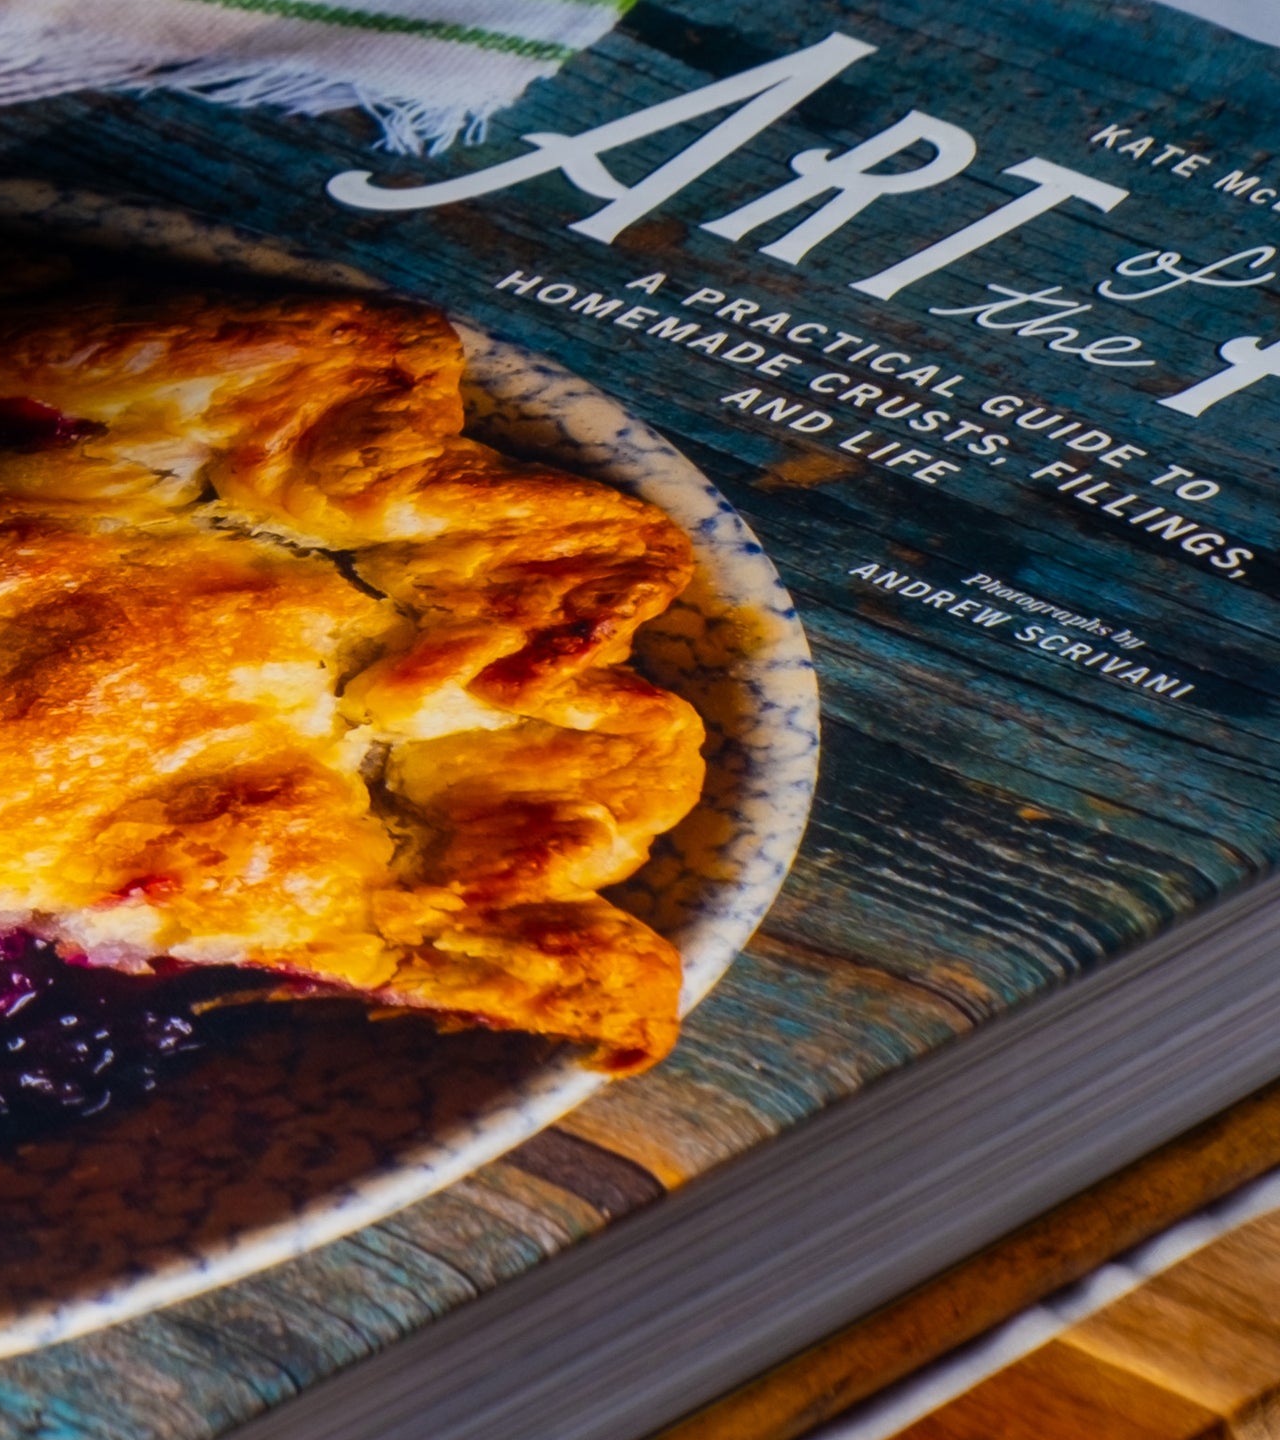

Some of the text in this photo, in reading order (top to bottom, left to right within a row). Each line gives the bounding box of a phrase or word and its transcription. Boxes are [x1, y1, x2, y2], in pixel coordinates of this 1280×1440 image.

[327, 31, 1277, 367] ART of the
[1091, 123, 1212, 178] KATE
[495, 270, 1254, 580] HOMEMADE CRUSTS, FILLINGS,
[625, 272, 1220, 502] A PRACTICAL GUIDE TO
[720, 387, 962, 484] AND LIFE
[848, 562, 1195, 700] ANDREW SCRIVANI
[961, 572, 1146, 651] Photographs by
